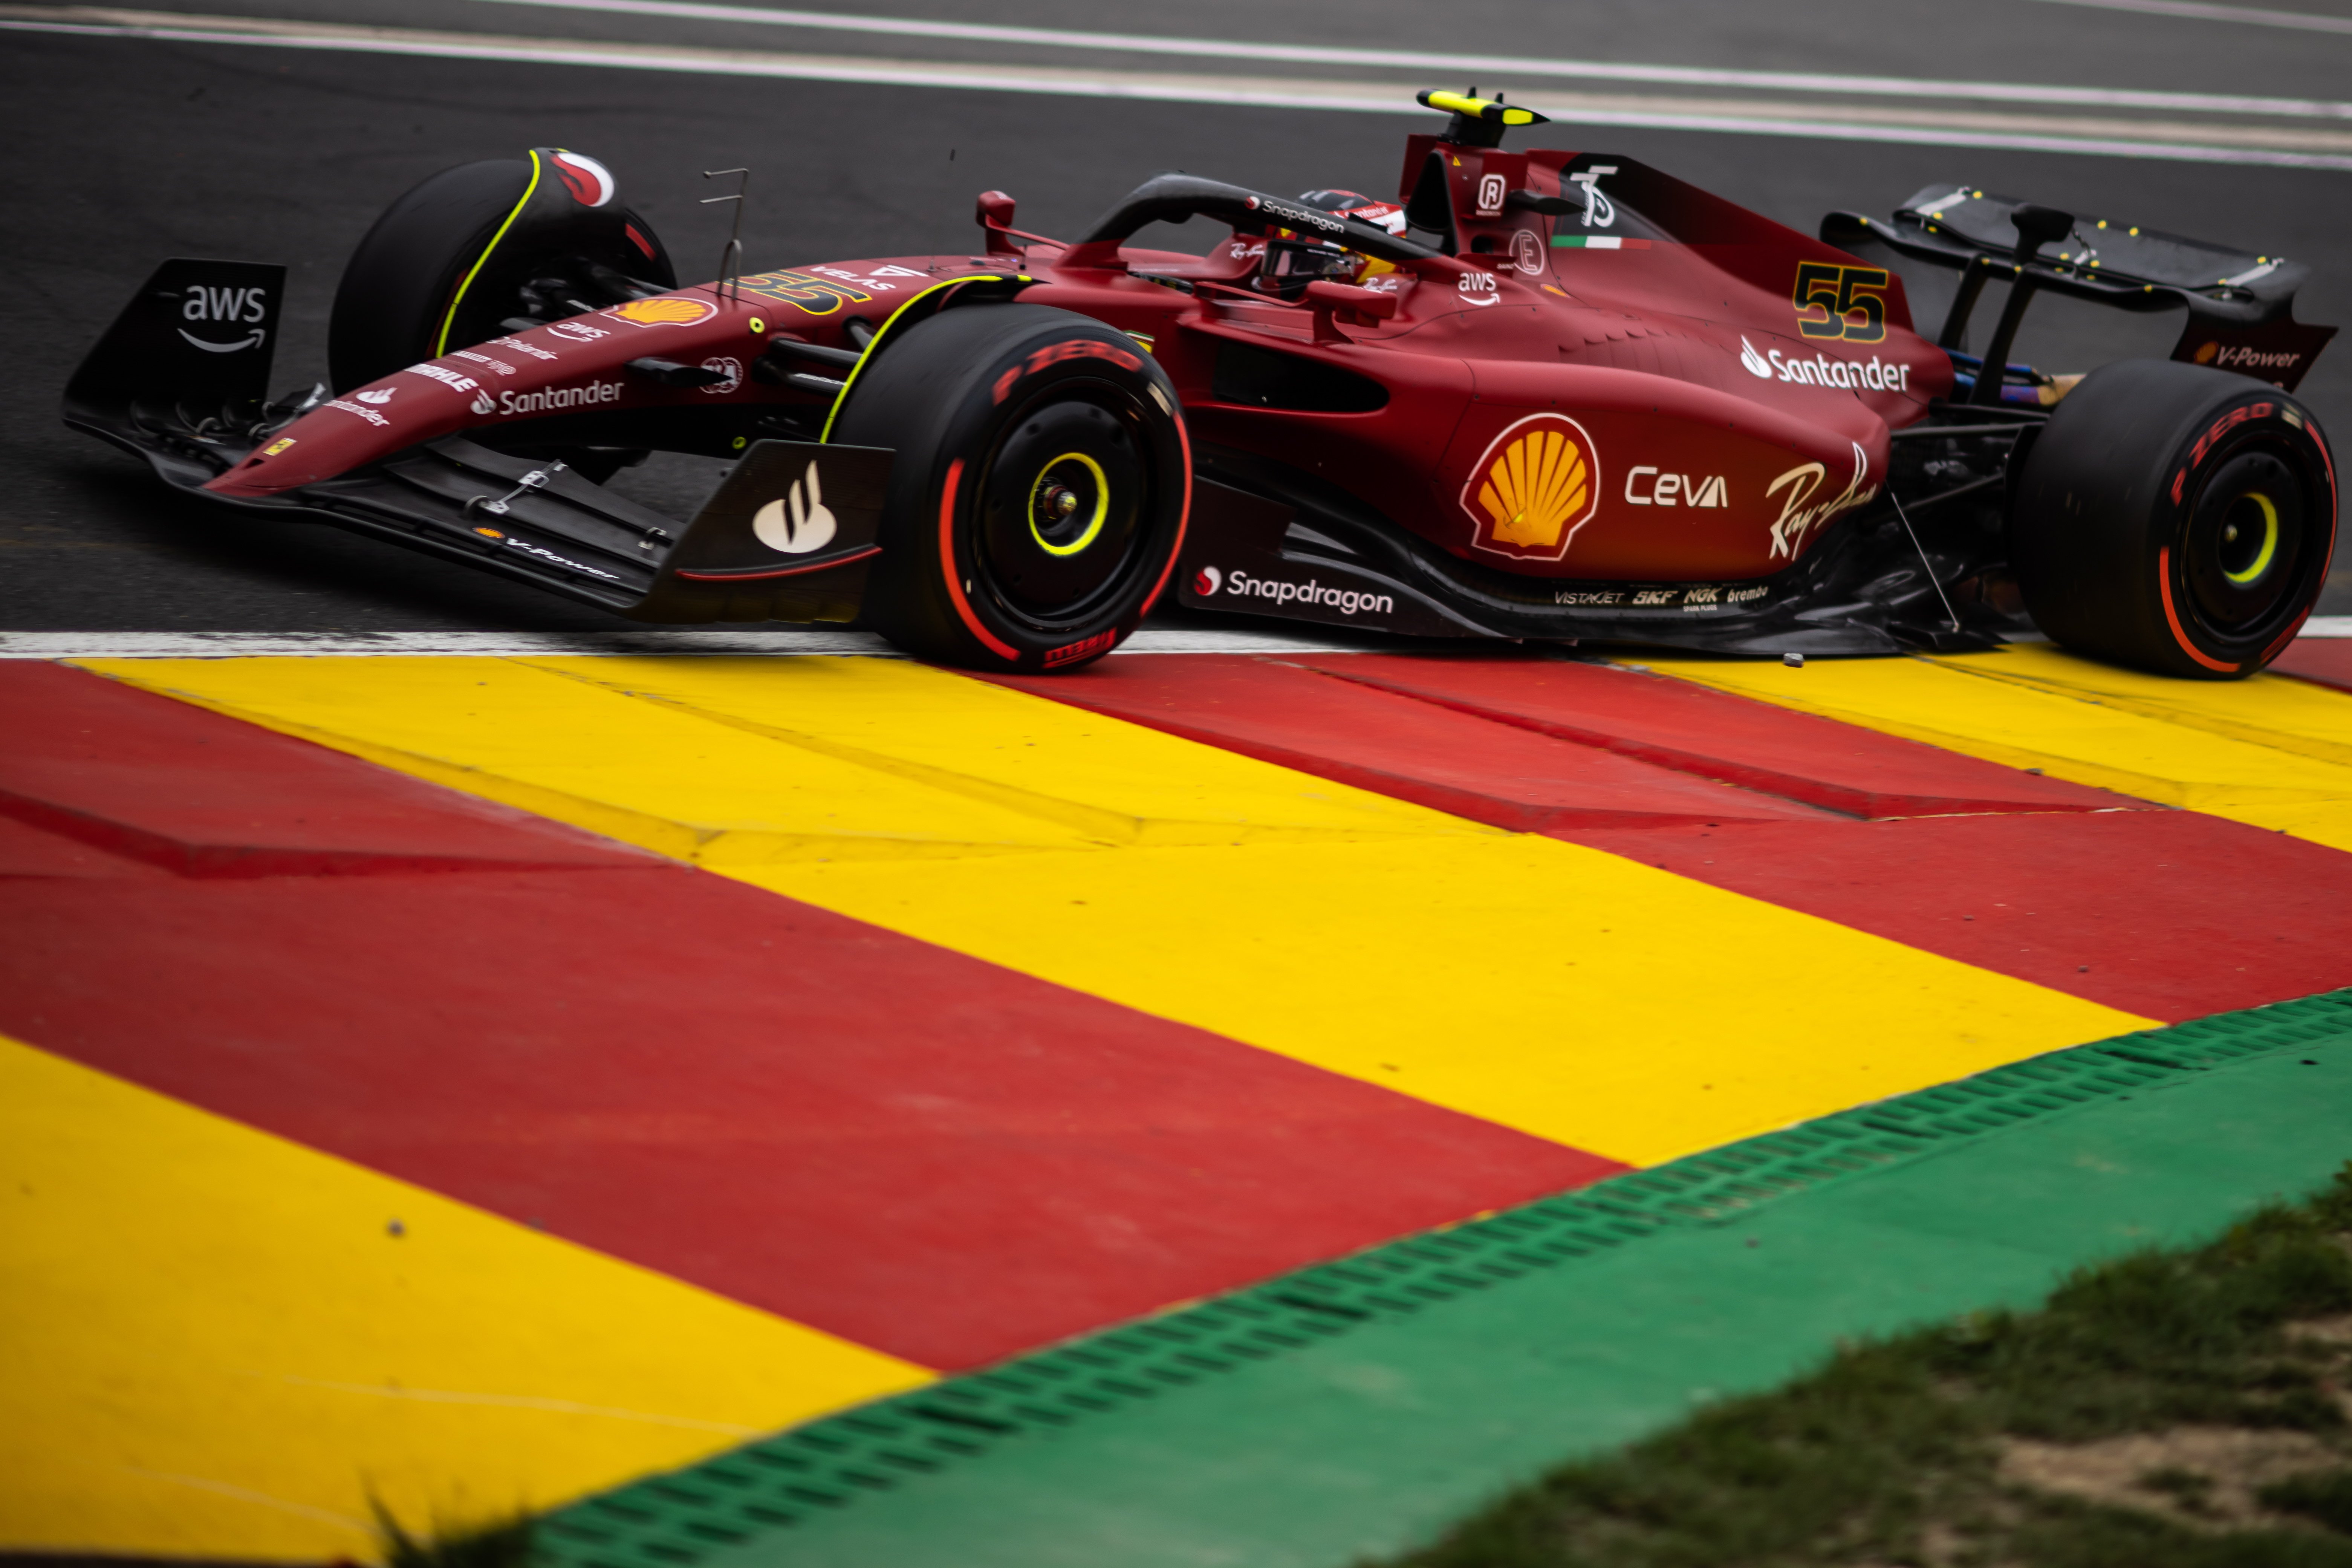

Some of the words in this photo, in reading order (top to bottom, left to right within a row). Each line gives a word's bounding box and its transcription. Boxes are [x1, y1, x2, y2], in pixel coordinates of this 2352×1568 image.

[1262, 200, 1345, 234] Snapdragon
[715, 269, 873, 315] 55
[810, 266, 897, 290] VELAS
[1458, 272, 1497, 292] aws
[183, 285, 266, 323] aws
[1792, 261, 1889, 344] 55
[556, 322, 612, 339] aws
[1025, 339, 1145, 376] ZERO
[1768, 349, 1910, 392] Santander
[2217, 346, 2300, 368] V-Power
[499, 379, 625, 415] Santander
[2188, 402, 2274, 471] ZERO
[505, 538, 621, 579] V-Power
[1226, 570, 1393, 615] Snapdragon
[1555, 589, 1625, 604] VISTAJET
[1632, 590, 1678, 604] SKF
[1683, 587, 1723, 603] NGK
[1727, 586, 1769, 603] brembo
